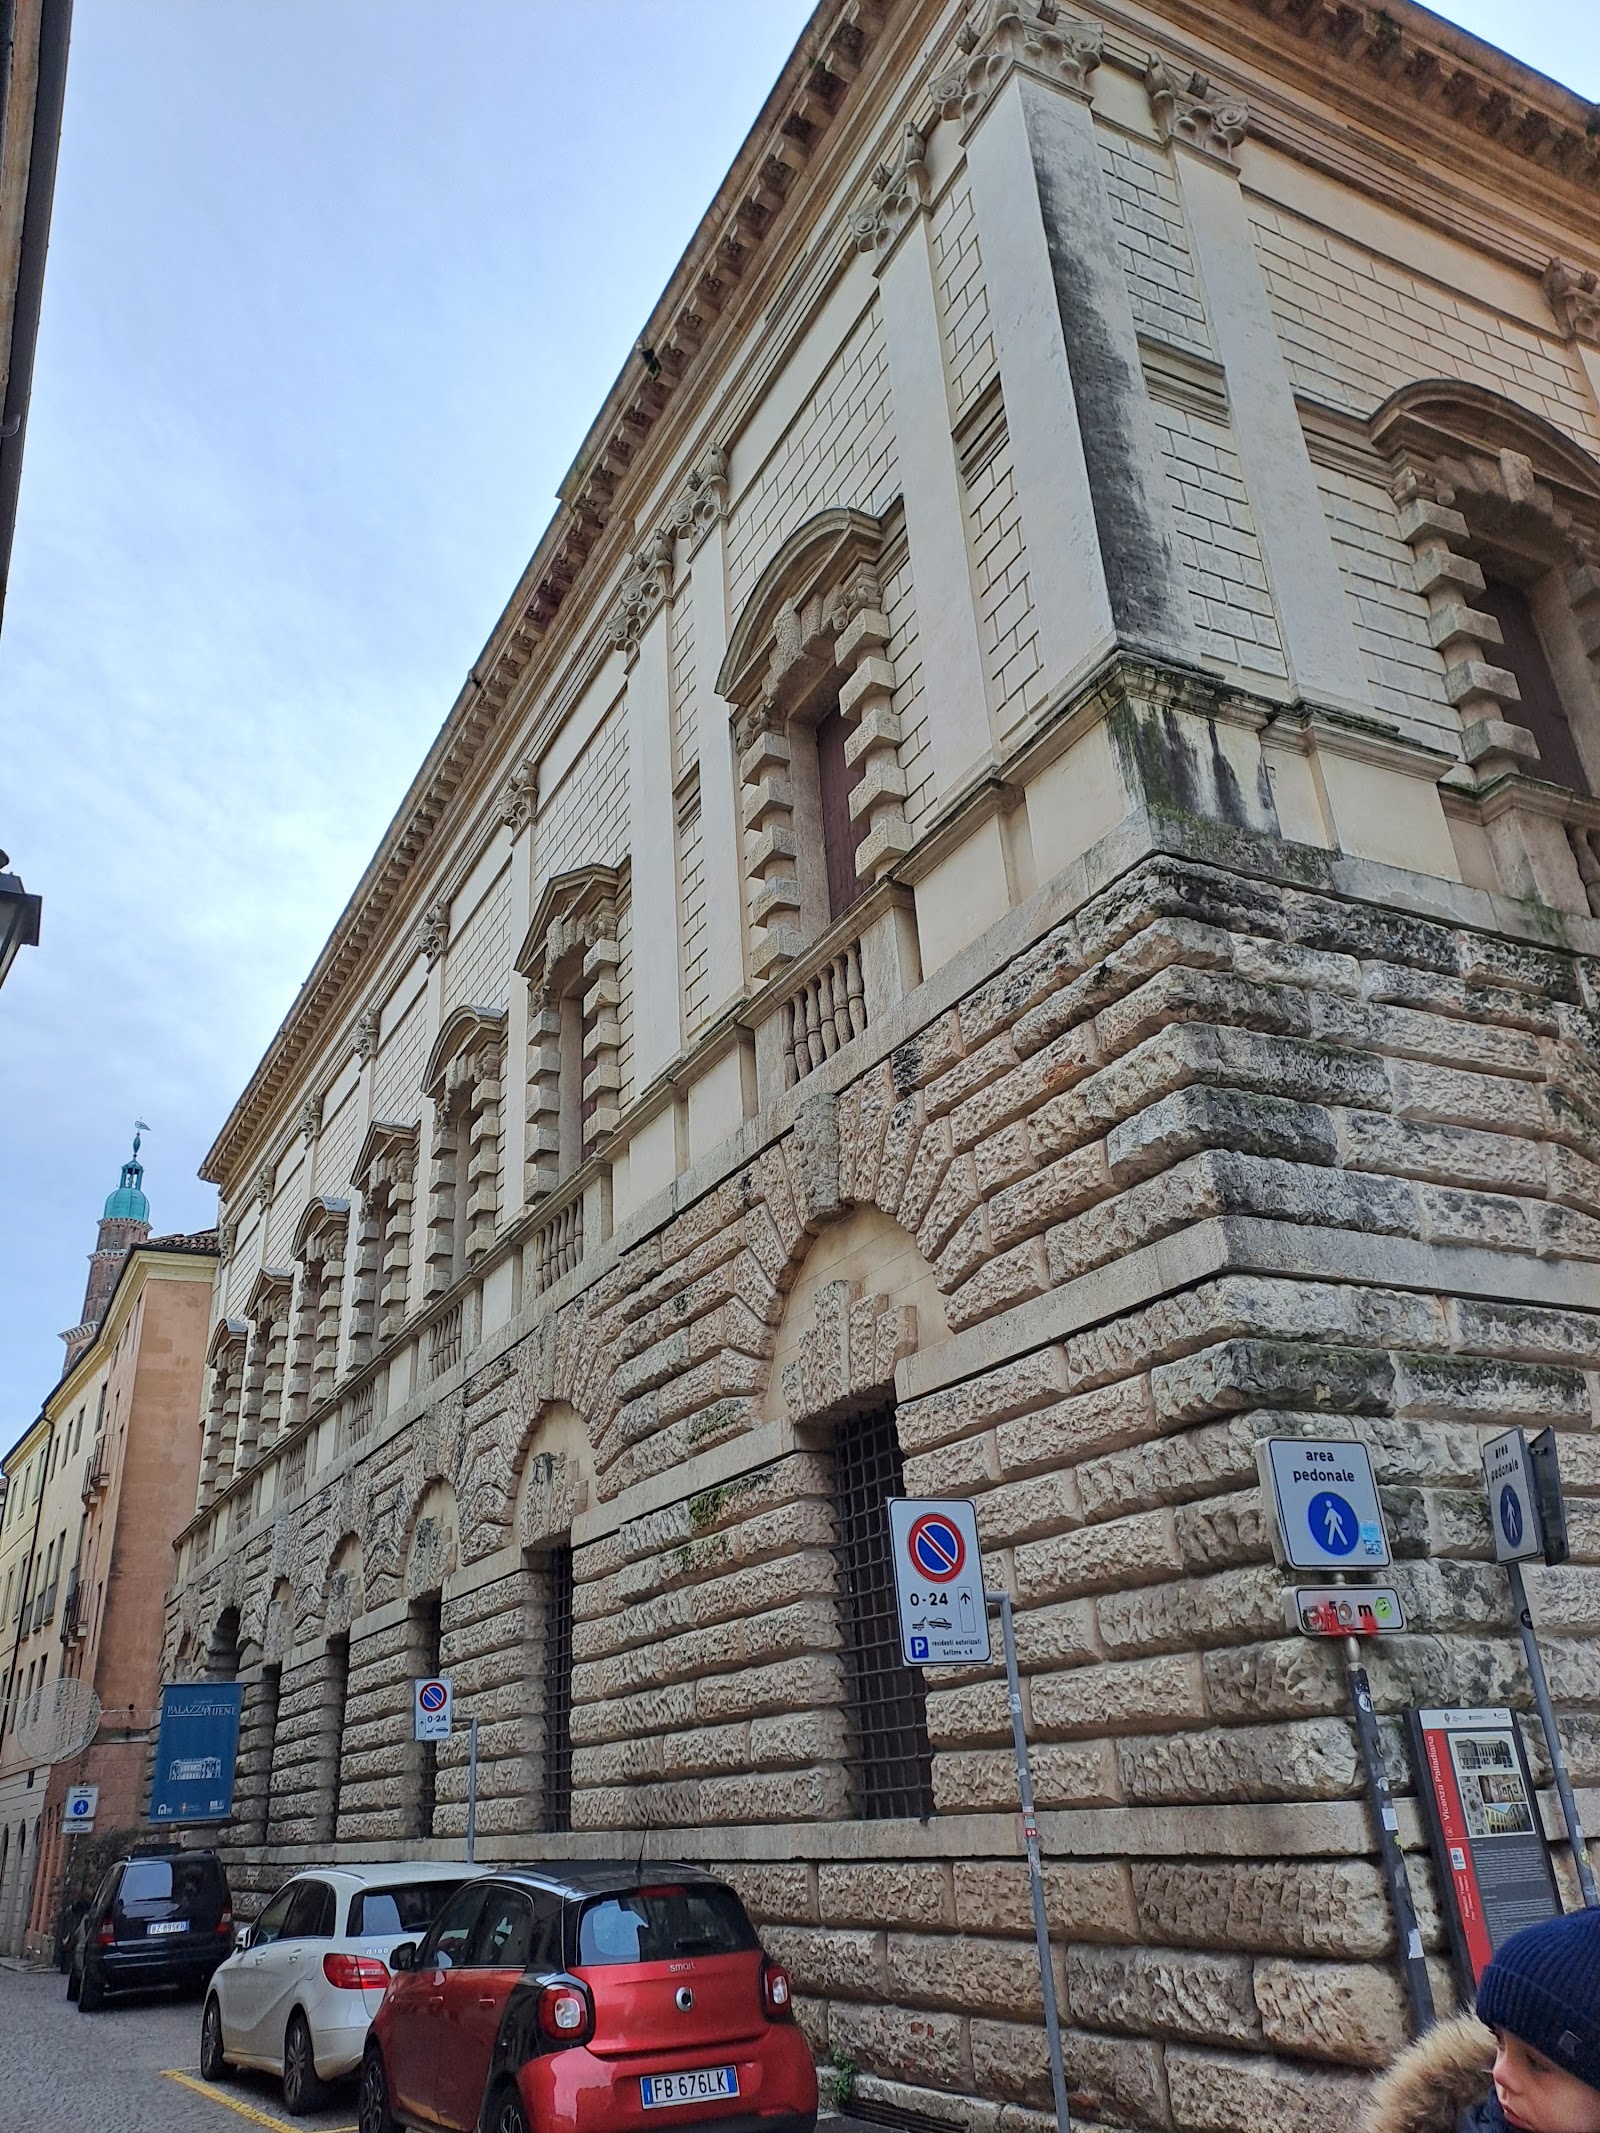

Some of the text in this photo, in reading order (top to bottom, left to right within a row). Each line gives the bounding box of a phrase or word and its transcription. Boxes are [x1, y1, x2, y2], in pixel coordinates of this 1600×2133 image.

[1306, 1451, 1334, 1462] area
[1495, 1444, 1508, 1459] area
[1293, 1469, 1355, 1483] pedonale
[1491, 1458, 1519, 1482] pedonale
[910, 1592, 949, 1606] 0-24
[167, 1704, 210, 1715] PALAZZO
[427, 1715, 447, 1723] 0-24
[1427, 1735, 1442, 1783] Palladiana
[1438, 1784, 1450, 1821] Vicenza
[669, 1961, 695, 1973] smart
[653, 2071, 727, 2100] FB 676LK
